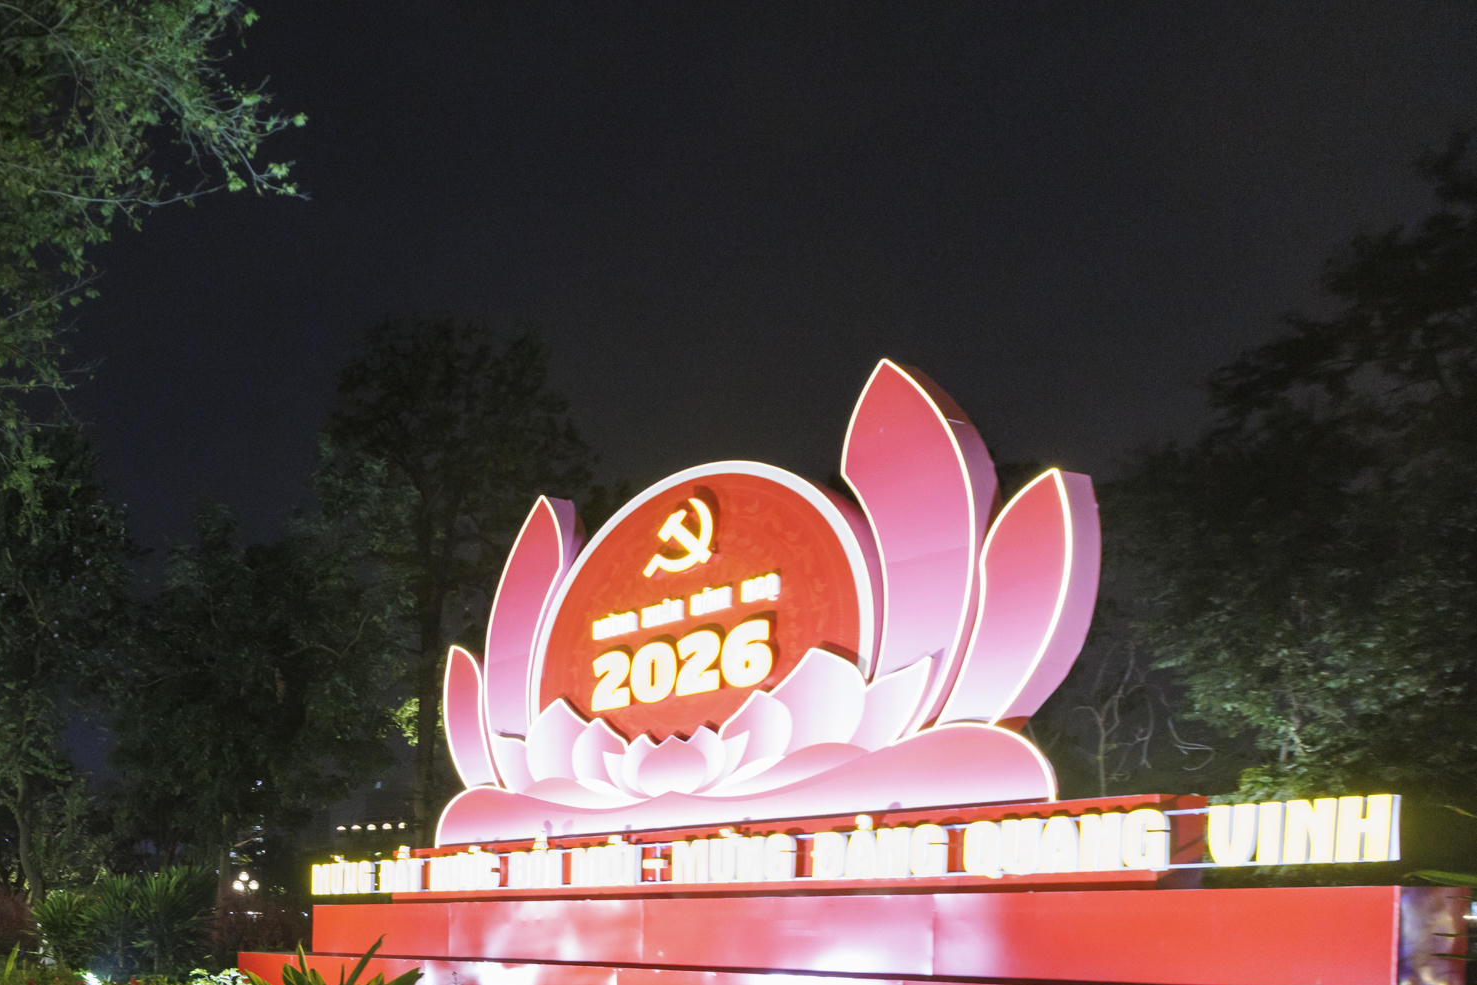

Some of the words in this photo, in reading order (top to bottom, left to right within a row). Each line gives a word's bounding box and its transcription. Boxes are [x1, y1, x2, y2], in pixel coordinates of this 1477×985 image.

[591, 619, 773, 712] 2026
[963, 809, 1171, 879] QUANG
[1207, 794, 1401, 867] VINH
